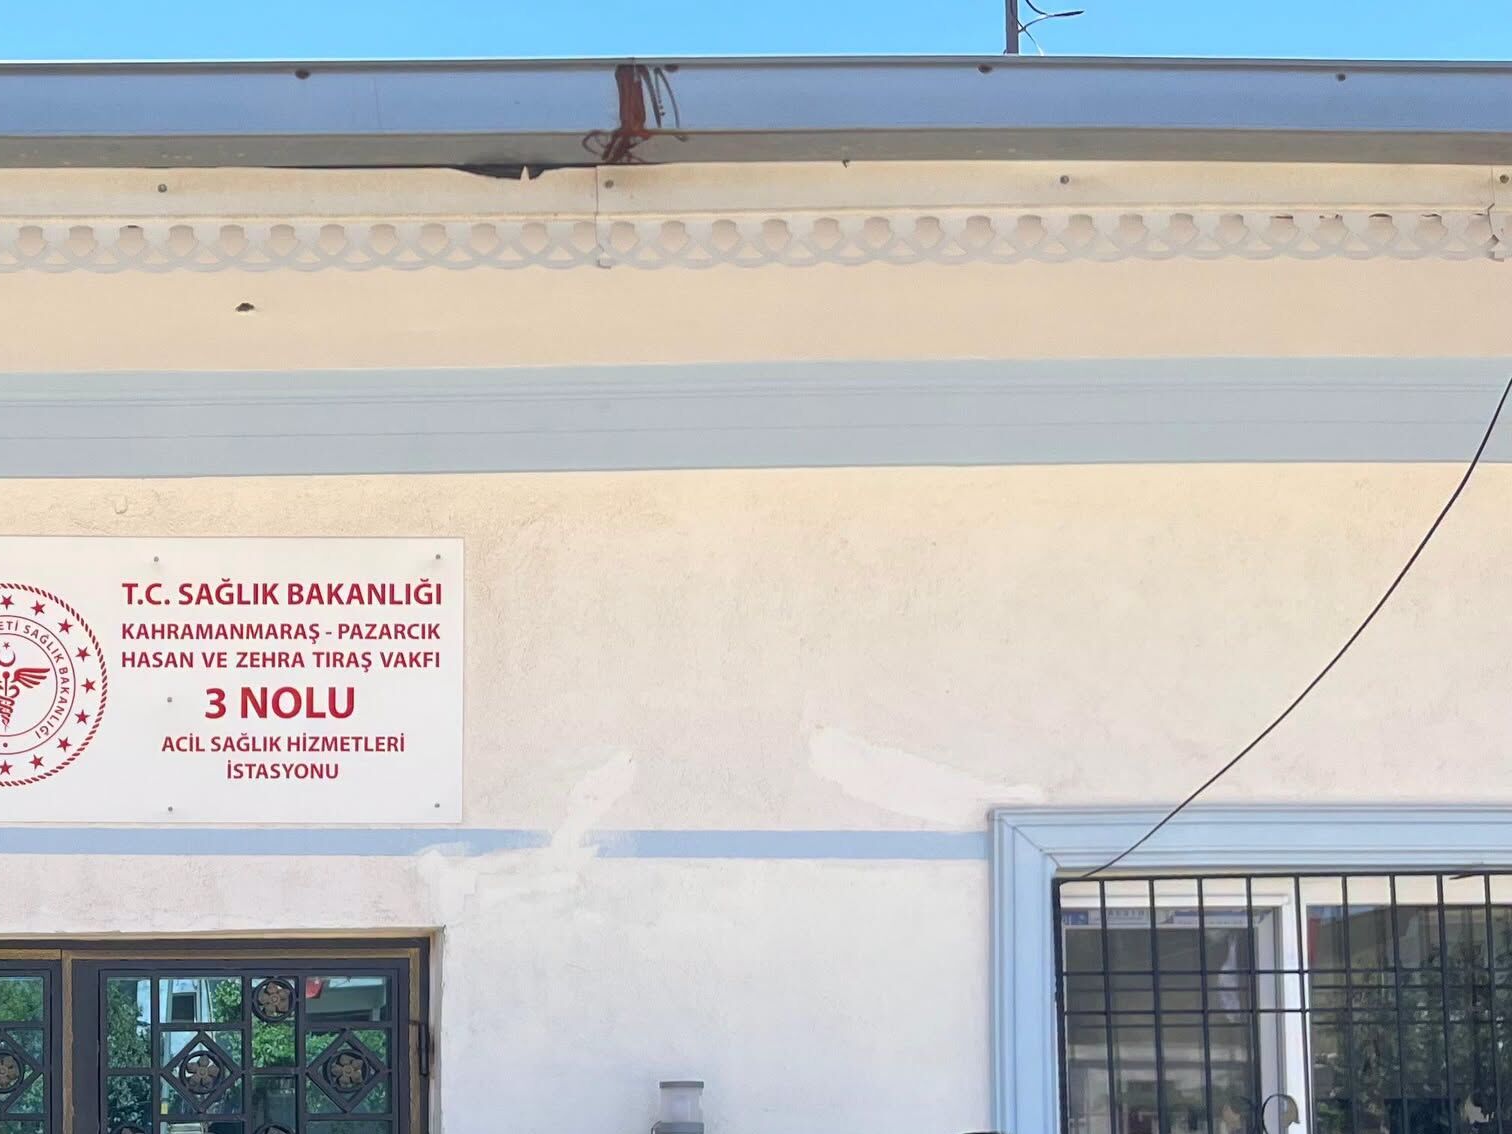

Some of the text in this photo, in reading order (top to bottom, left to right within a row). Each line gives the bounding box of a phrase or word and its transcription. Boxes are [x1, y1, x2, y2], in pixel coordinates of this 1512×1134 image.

[121, 577, 443, 606] T.C. SAĞLIK BAKANLIĞI
[23, 624, 65, 664] SAĞLIK
[121, 623, 321, 644] KAHRAMANMARAŞ
[337, 623, 441, 640] PAZARCIK
[121, 650, 441, 673] HASAN VE ZEHRA TIRAŞ VAKFI
[34, 666, 71, 740] BAKANLIĞI
[204, 686, 356, 720] 3 NOLU
[162, 732, 406, 753] ACİL SAĞLIK HİZMETLERİ
[226, 761, 340, 780] İSTASYONU
